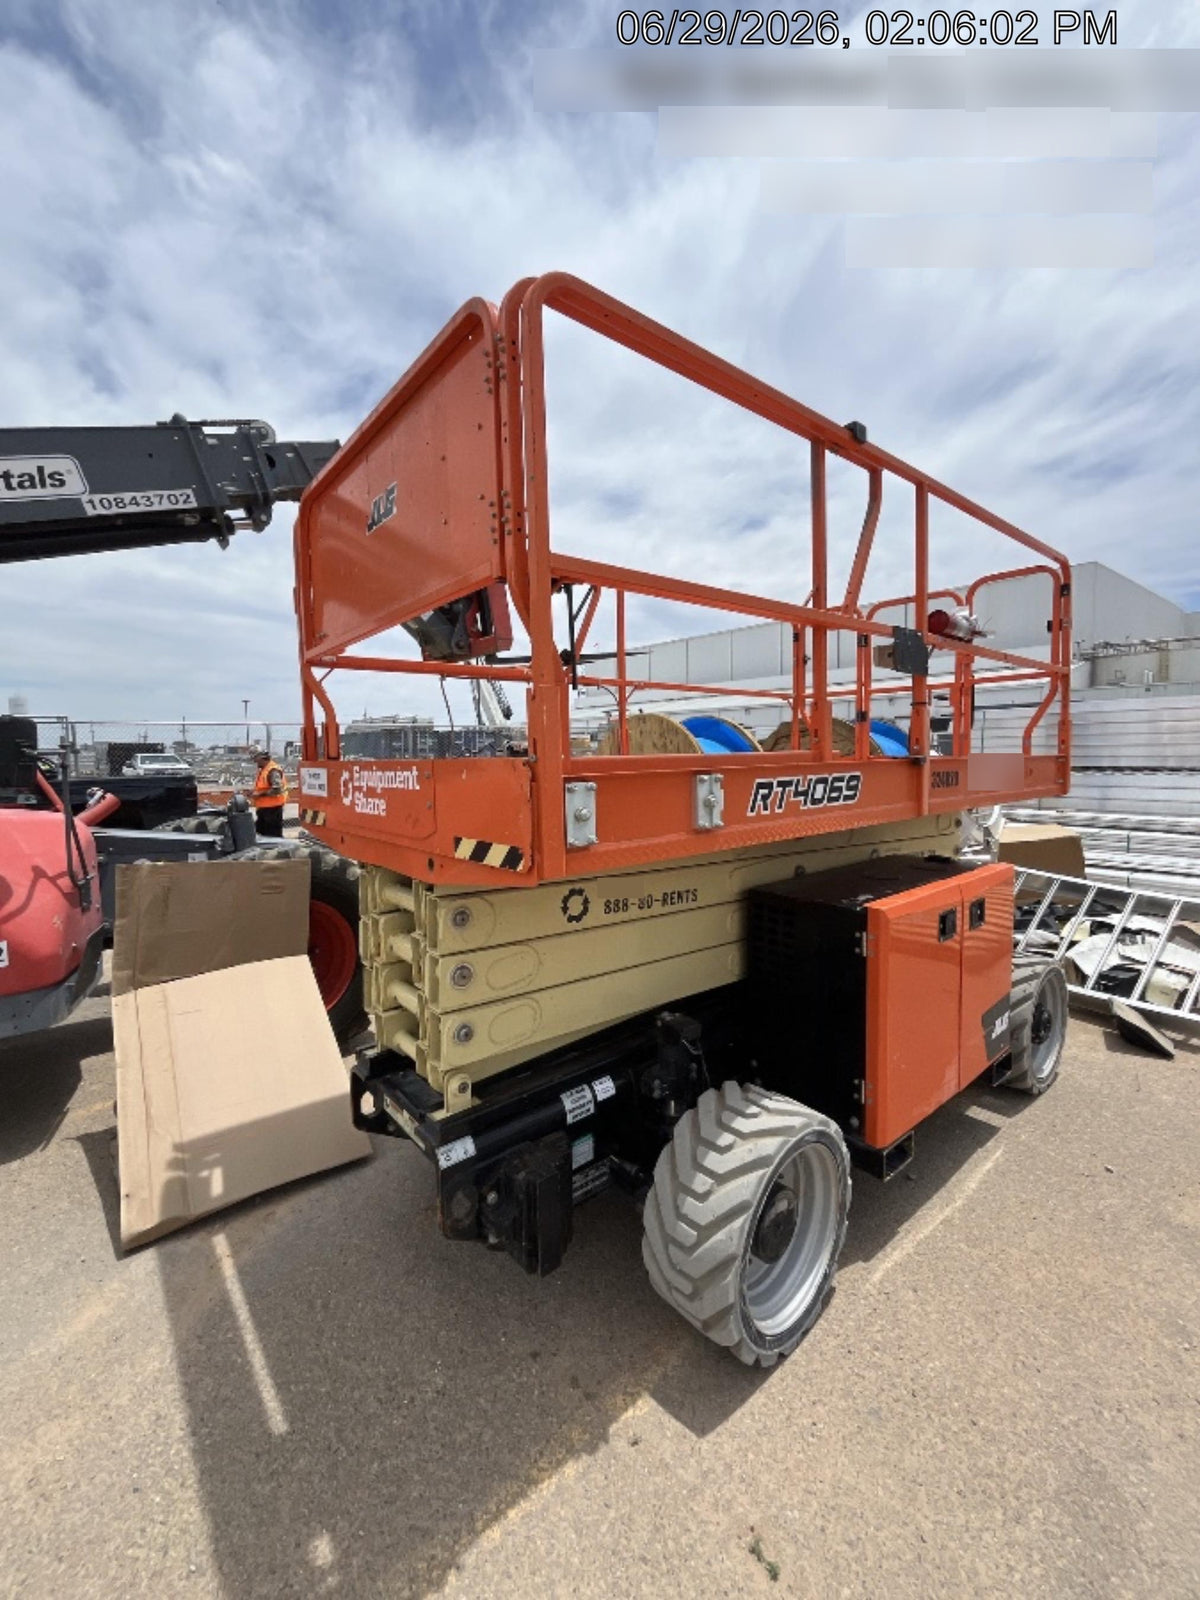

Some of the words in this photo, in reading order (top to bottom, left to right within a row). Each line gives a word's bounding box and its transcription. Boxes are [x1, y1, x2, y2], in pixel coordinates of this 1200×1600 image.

[86, 492, 193, 511] 10843702
[353, 765, 420, 793] Equipment
[354, 791, 387, 816] Share
[748, 772, 861, 816] RT4069
